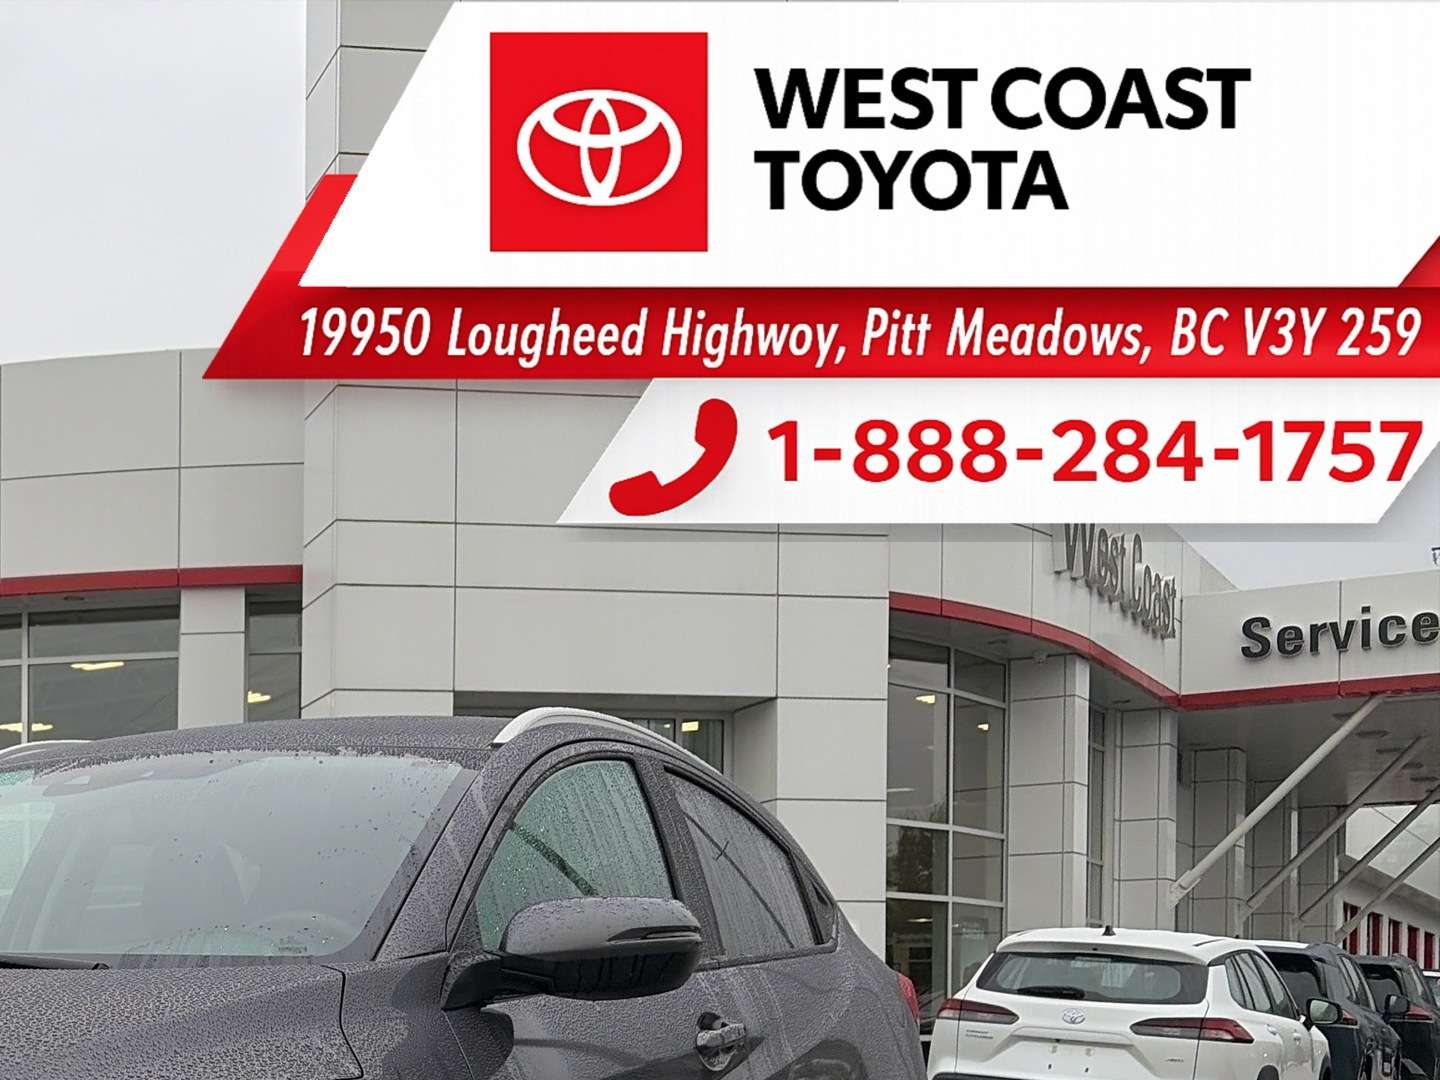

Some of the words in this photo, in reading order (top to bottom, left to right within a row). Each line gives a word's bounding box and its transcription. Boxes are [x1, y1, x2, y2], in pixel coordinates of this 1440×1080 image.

[1063, 523, 1127, 598] West
[1132, 532, 1177, 640] Coast
[1240, 605, 1440, 661] Service
